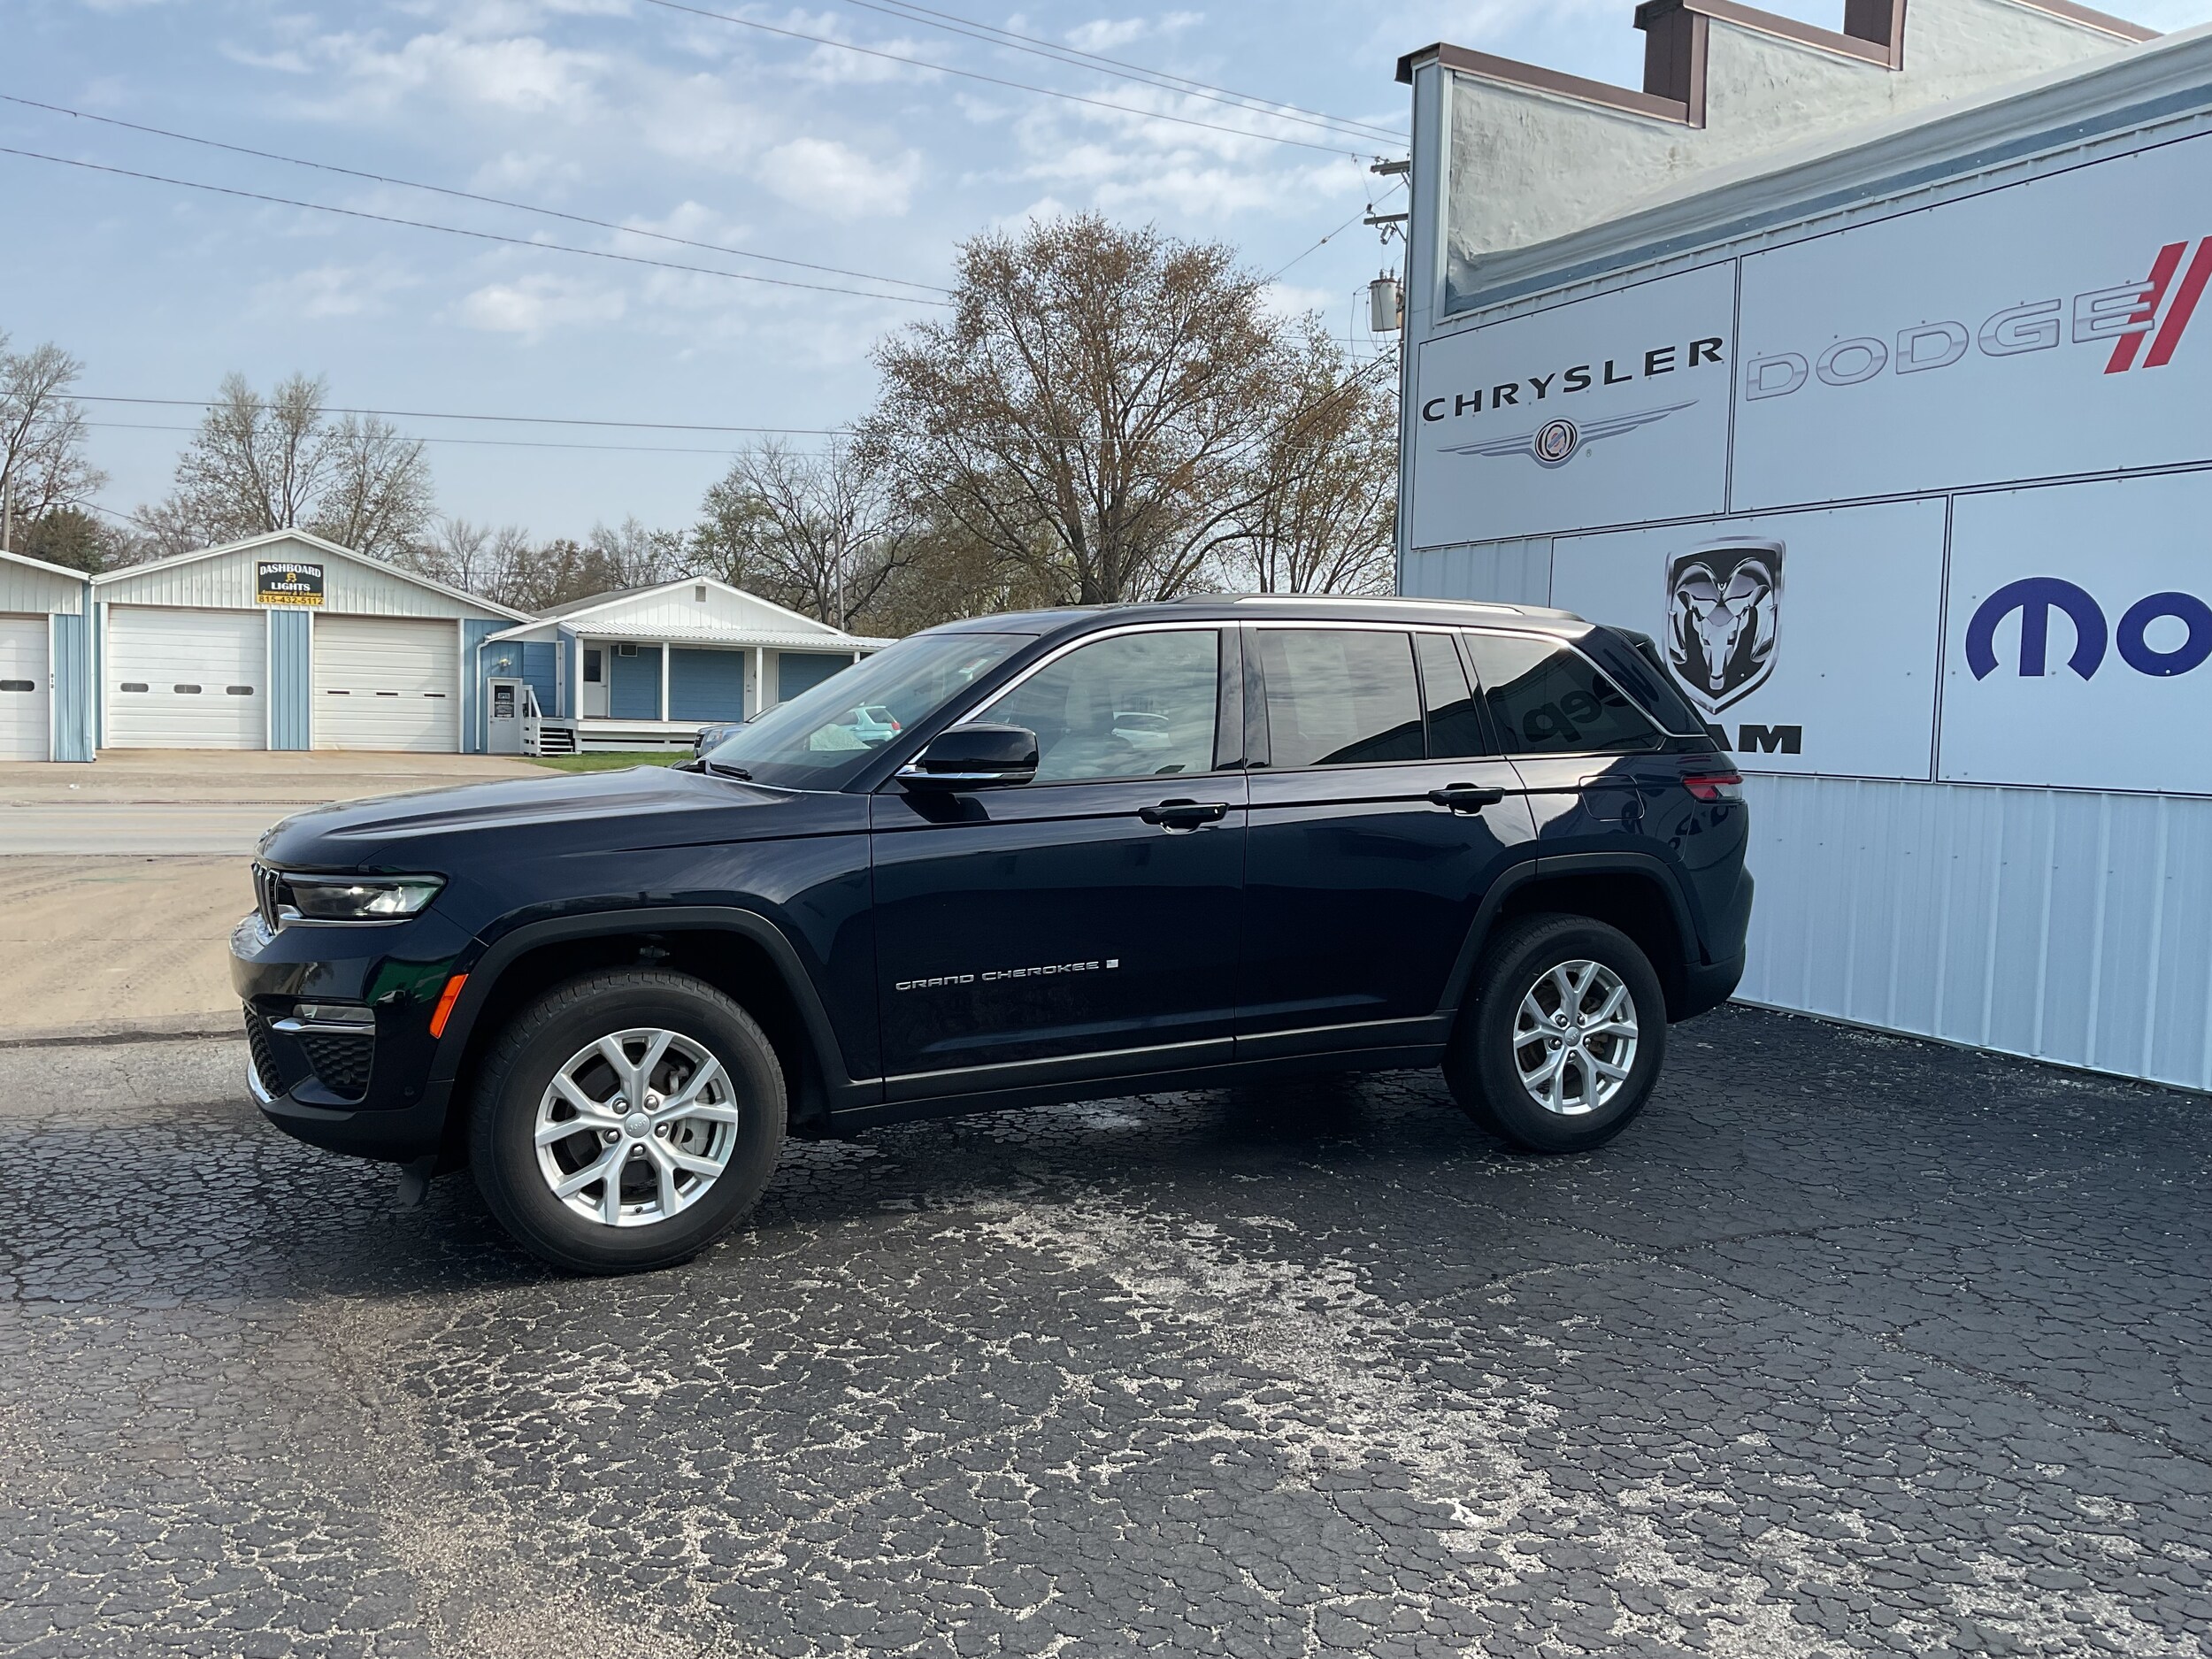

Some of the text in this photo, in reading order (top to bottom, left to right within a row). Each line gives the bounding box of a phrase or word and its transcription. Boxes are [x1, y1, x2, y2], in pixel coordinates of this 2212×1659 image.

[1746, 280, 2155, 402] DODGE
[1422, 337, 1724, 422] CHRYSLER
[259, 564, 321, 578] DASHBOARD
[271, 581, 311, 591] LIGHTS
[259, 595, 323, 604] 815-432-5112
[895, 961, 1100, 991] GRAND CHEROKEE
